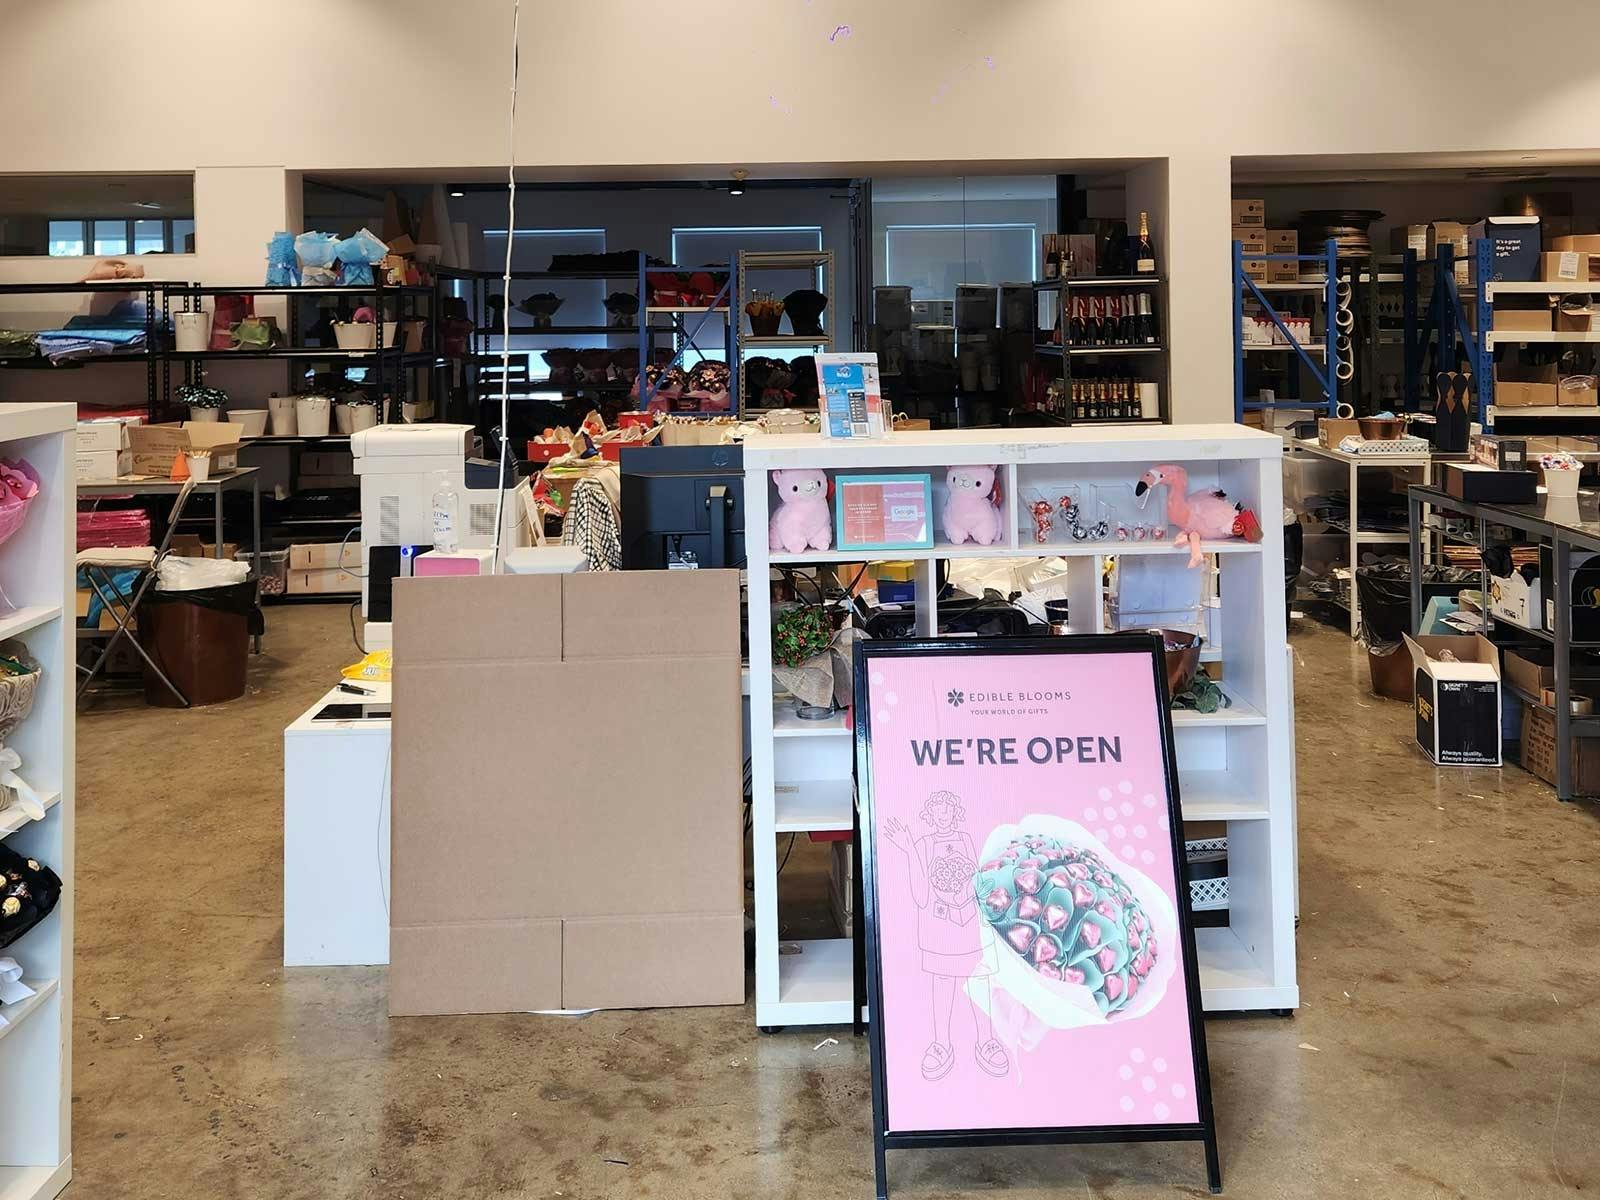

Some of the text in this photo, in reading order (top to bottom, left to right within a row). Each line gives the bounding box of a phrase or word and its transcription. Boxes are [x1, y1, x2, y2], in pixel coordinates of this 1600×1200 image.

[969, 691, 1072, 702] EDIBLE BLOOMS
[910, 736, 1122, 766] WE'RE OPEN
